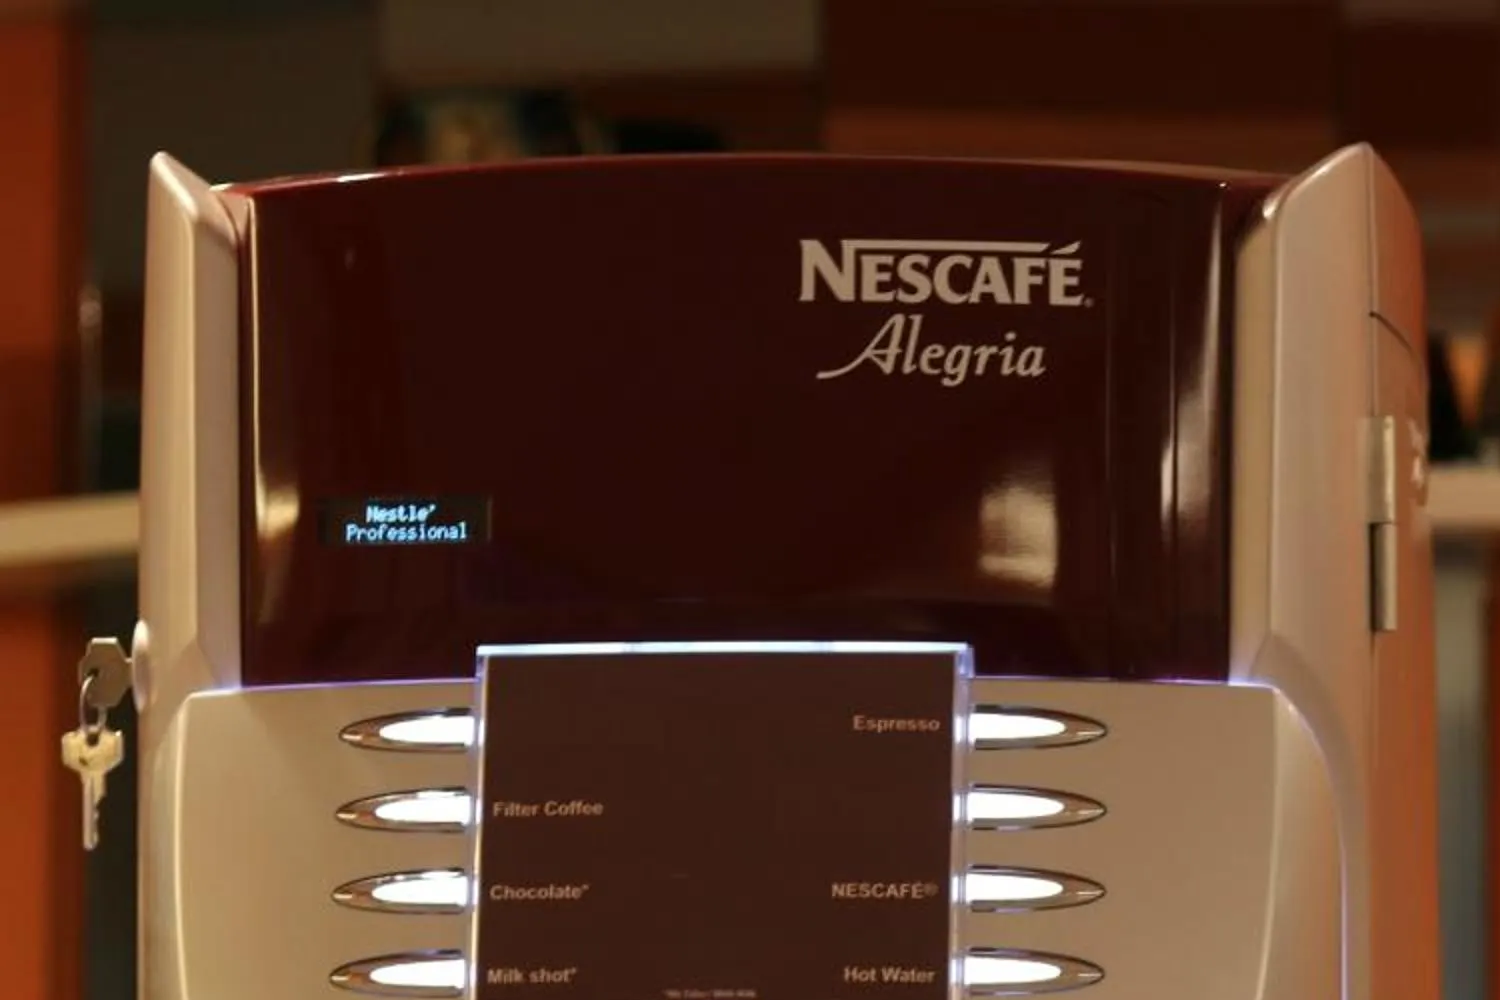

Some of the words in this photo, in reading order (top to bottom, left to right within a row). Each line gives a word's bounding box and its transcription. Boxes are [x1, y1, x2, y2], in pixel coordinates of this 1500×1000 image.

[816, 313, 1046, 387] Alegria
[345, 522, 467, 541] Professional
[852, 714, 941, 733] Espresso
[493, 801, 539, 817] Filter
[543, 800, 604, 817] Coffee
[487, 968, 524, 984] Milk
[843, 966, 877, 983] Hot
[880, 967, 936, 983] Water
